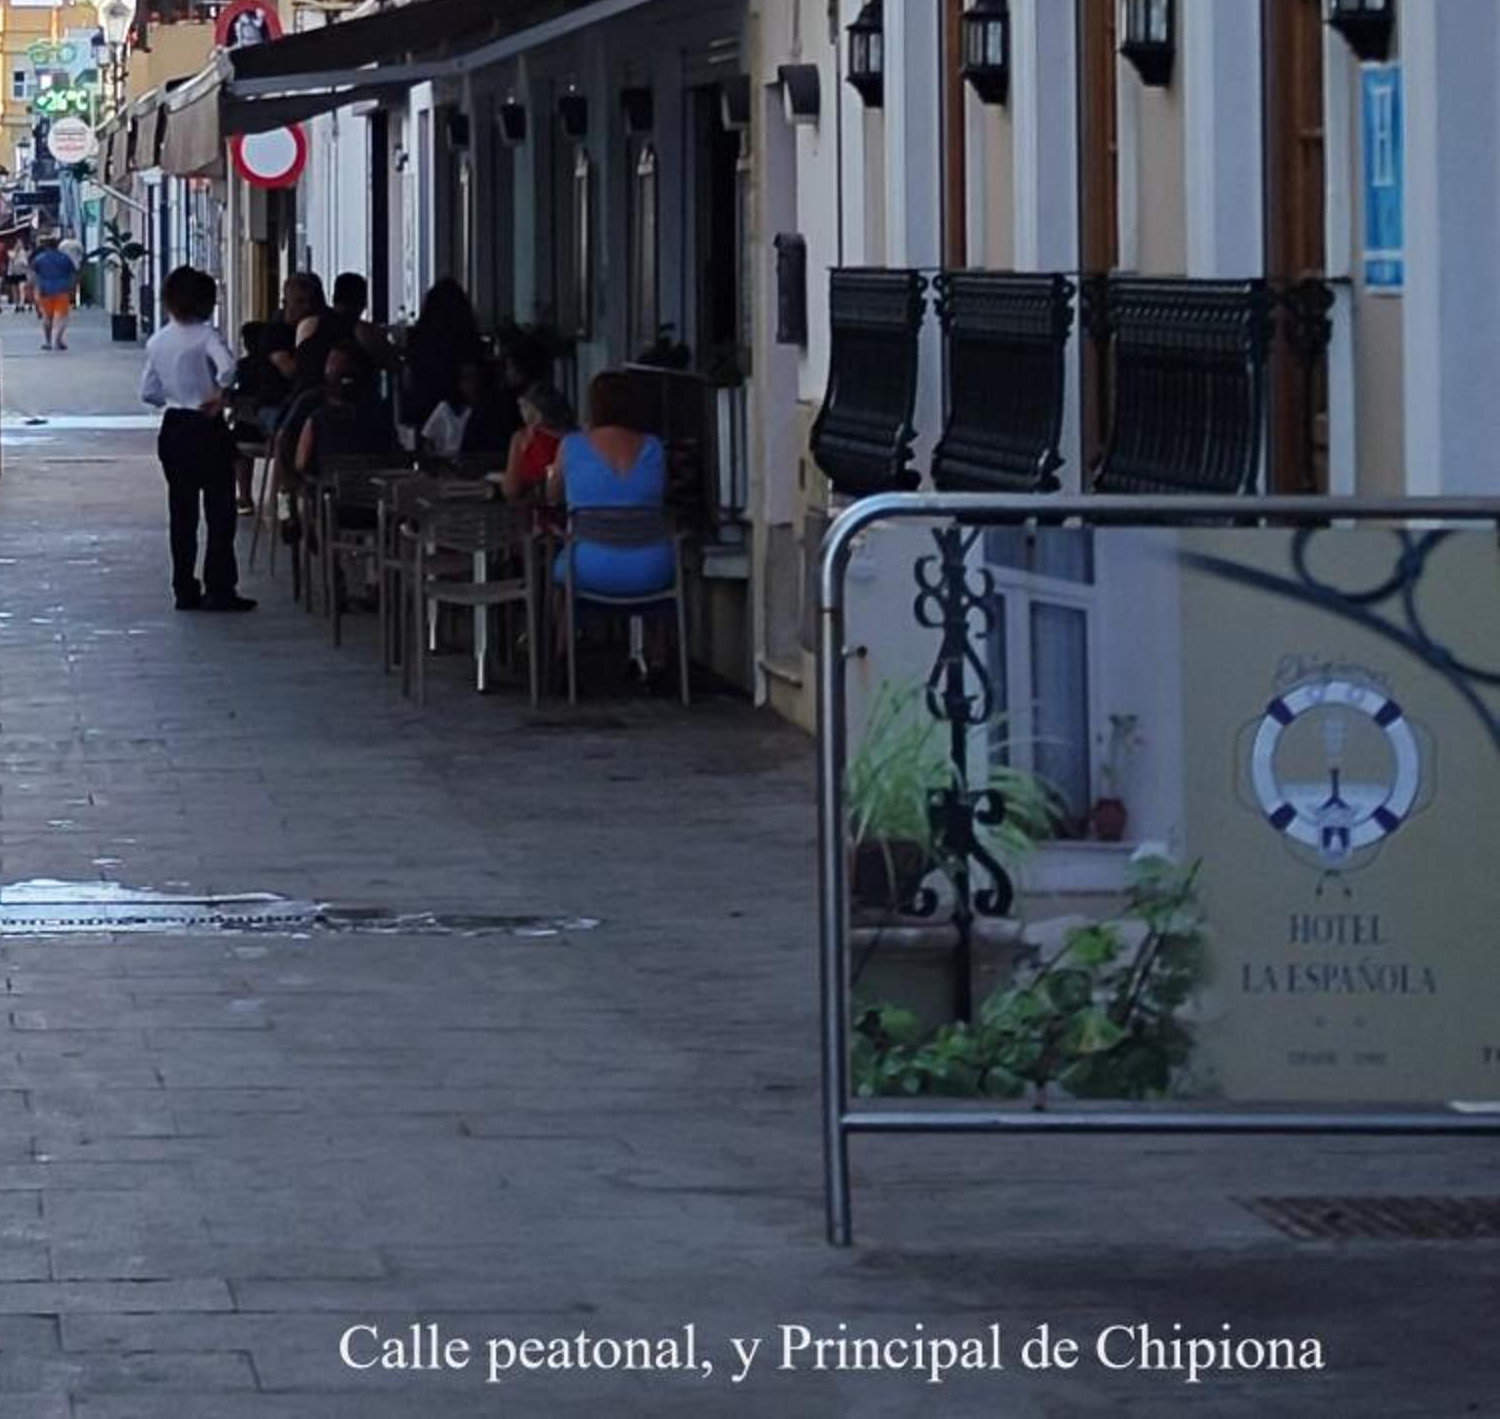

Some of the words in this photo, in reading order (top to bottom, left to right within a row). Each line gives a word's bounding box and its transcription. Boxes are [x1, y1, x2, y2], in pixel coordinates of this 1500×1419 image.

[1288, 912, 1386, 945] HOTEL
[1241, 961, 1278, 995] LA
[1284, 954, 1438, 995] ESPAÑOLA
